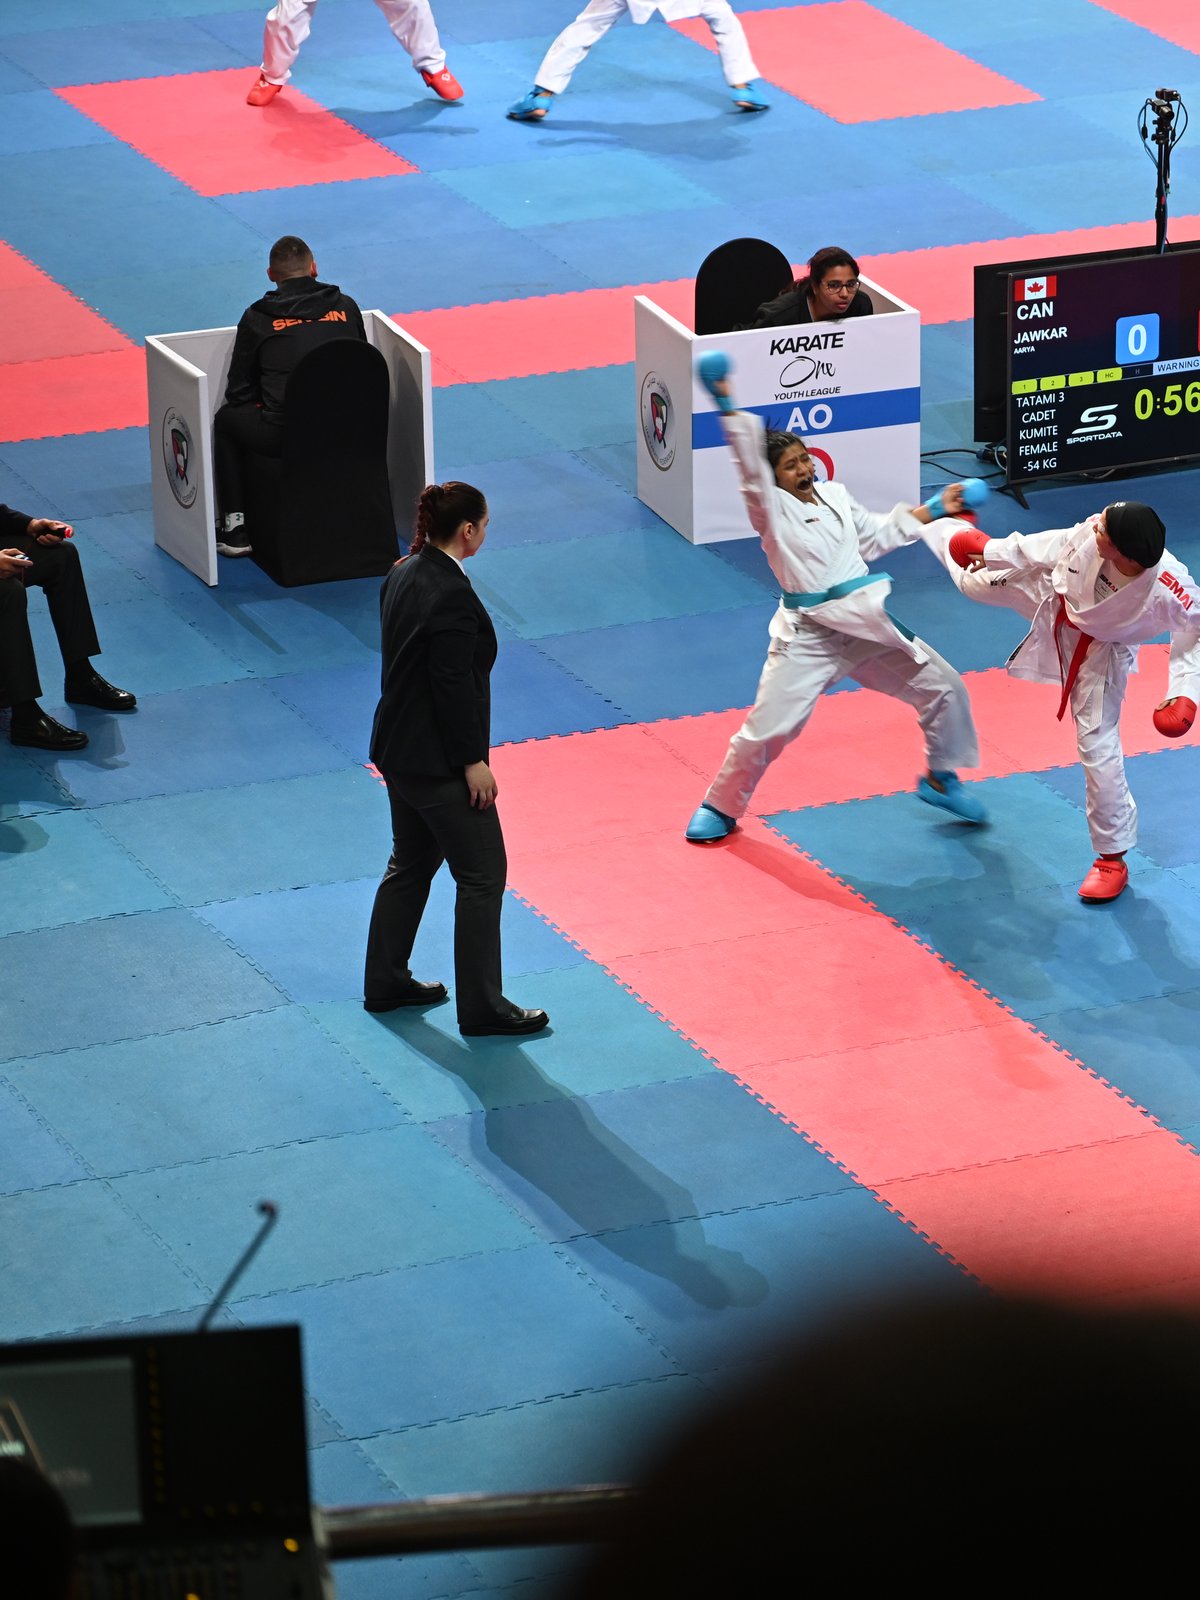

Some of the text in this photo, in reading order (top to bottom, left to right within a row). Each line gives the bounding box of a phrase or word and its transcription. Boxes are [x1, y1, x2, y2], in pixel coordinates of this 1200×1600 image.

[1016, 301, 1054, 320] CAN
[1013, 326, 1068, 344] JAWKAR
[1128, 324, 1147, 356] 0
[769, 331, 845, 356] KARATE
[780, 355, 837, 388] One
[1157, 359, 1200, 372] WARNING
[774, 386, 841, 401] YOUTH LEAGUE
[1016, 392, 1065, 408] TATAMI 3
[785, 403, 833, 432] AO
[1021, 409, 1056, 424] CADET
[1019, 425, 1058, 440] KUMITE
[1066, 431, 1123, 445] SPORTDATA
[1019, 441, 1058, 457] FEMALE
[1023, 457, 1057, 472] -54 KG
[1157, 570, 1194, 611] SMAI
